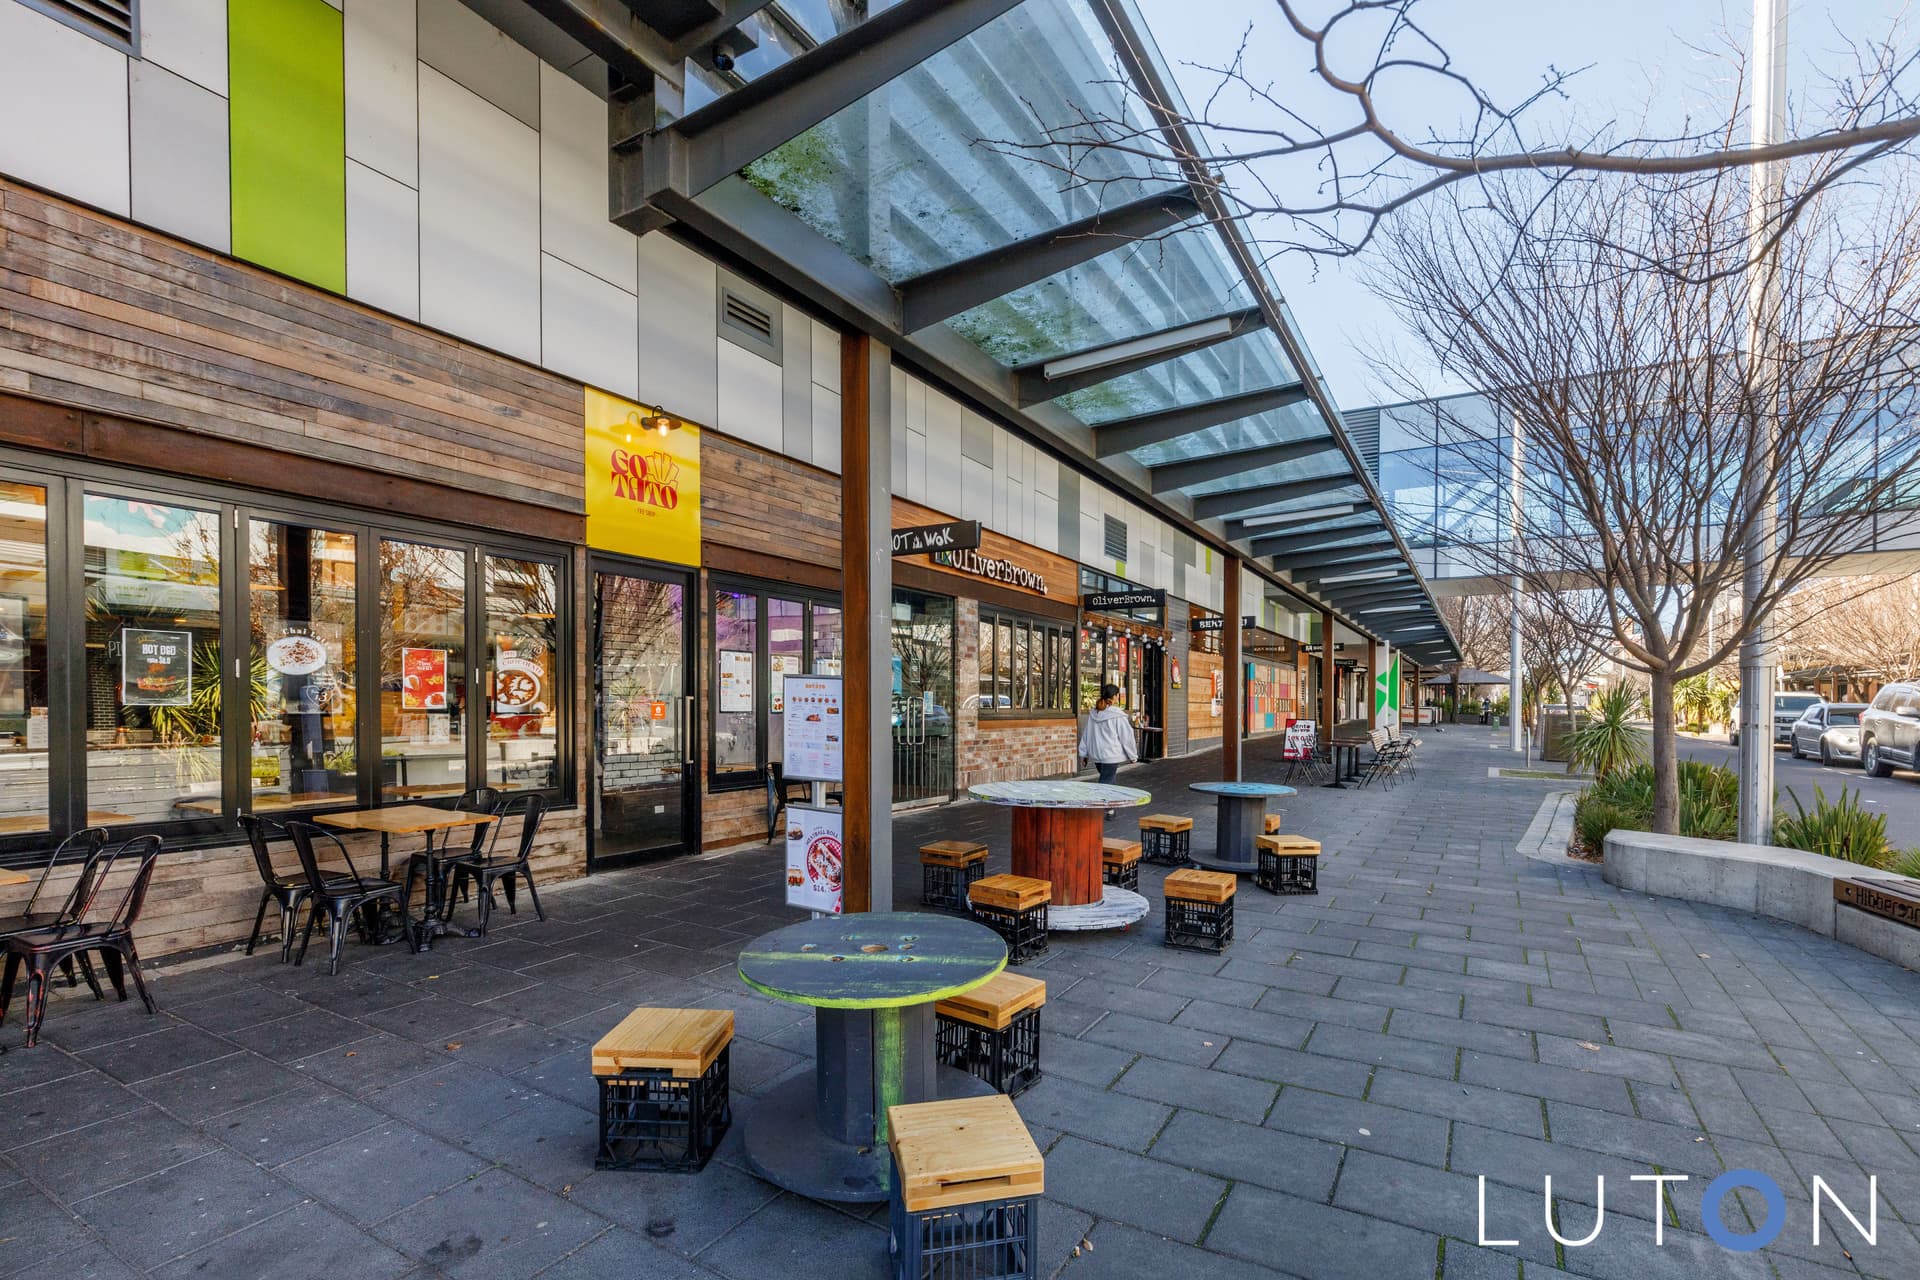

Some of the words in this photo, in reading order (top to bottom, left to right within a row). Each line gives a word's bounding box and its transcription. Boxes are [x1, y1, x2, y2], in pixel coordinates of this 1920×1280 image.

[611, 449, 647, 479] GO
[611, 471, 677, 510] TATO
[953, 548, 1048, 595] OliverBrown.
[1092, 594, 1156, 606] OliverBrown.
[282, 627, 307, 635] Chai
